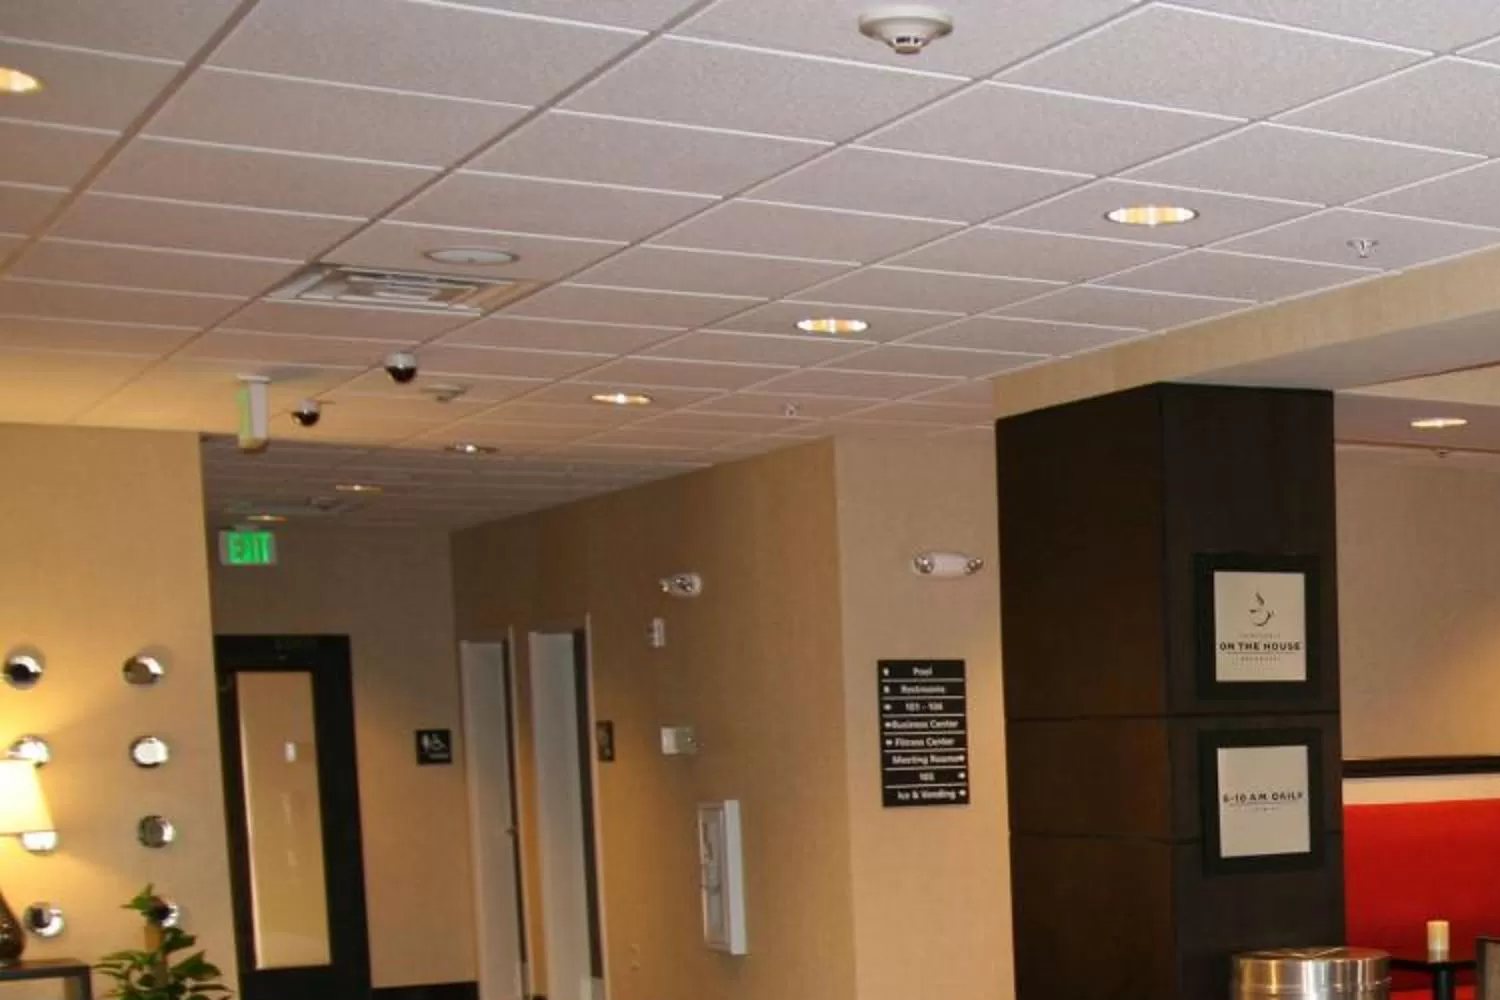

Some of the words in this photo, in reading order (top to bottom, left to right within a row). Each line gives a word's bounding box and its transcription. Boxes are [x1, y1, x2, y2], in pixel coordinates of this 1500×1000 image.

[228, 532, 271, 565] EXIT
[1219, 641, 1235, 651] ON
[1237, 641, 1260, 651] THE
[1263, 641, 1301, 651] HOUSE
[929, 720, 959, 729] Center
[894, 738, 925, 747] Fitness
[925, 738, 955, 747] Center
[891, 756, 928, 765] Meeting
[897, 791, 911, 800] Ice
[921, 789, 956, 800] Vending
[1250, 793, 1267, 801] AM
[1271, 791, 1303, 801] DAILY
